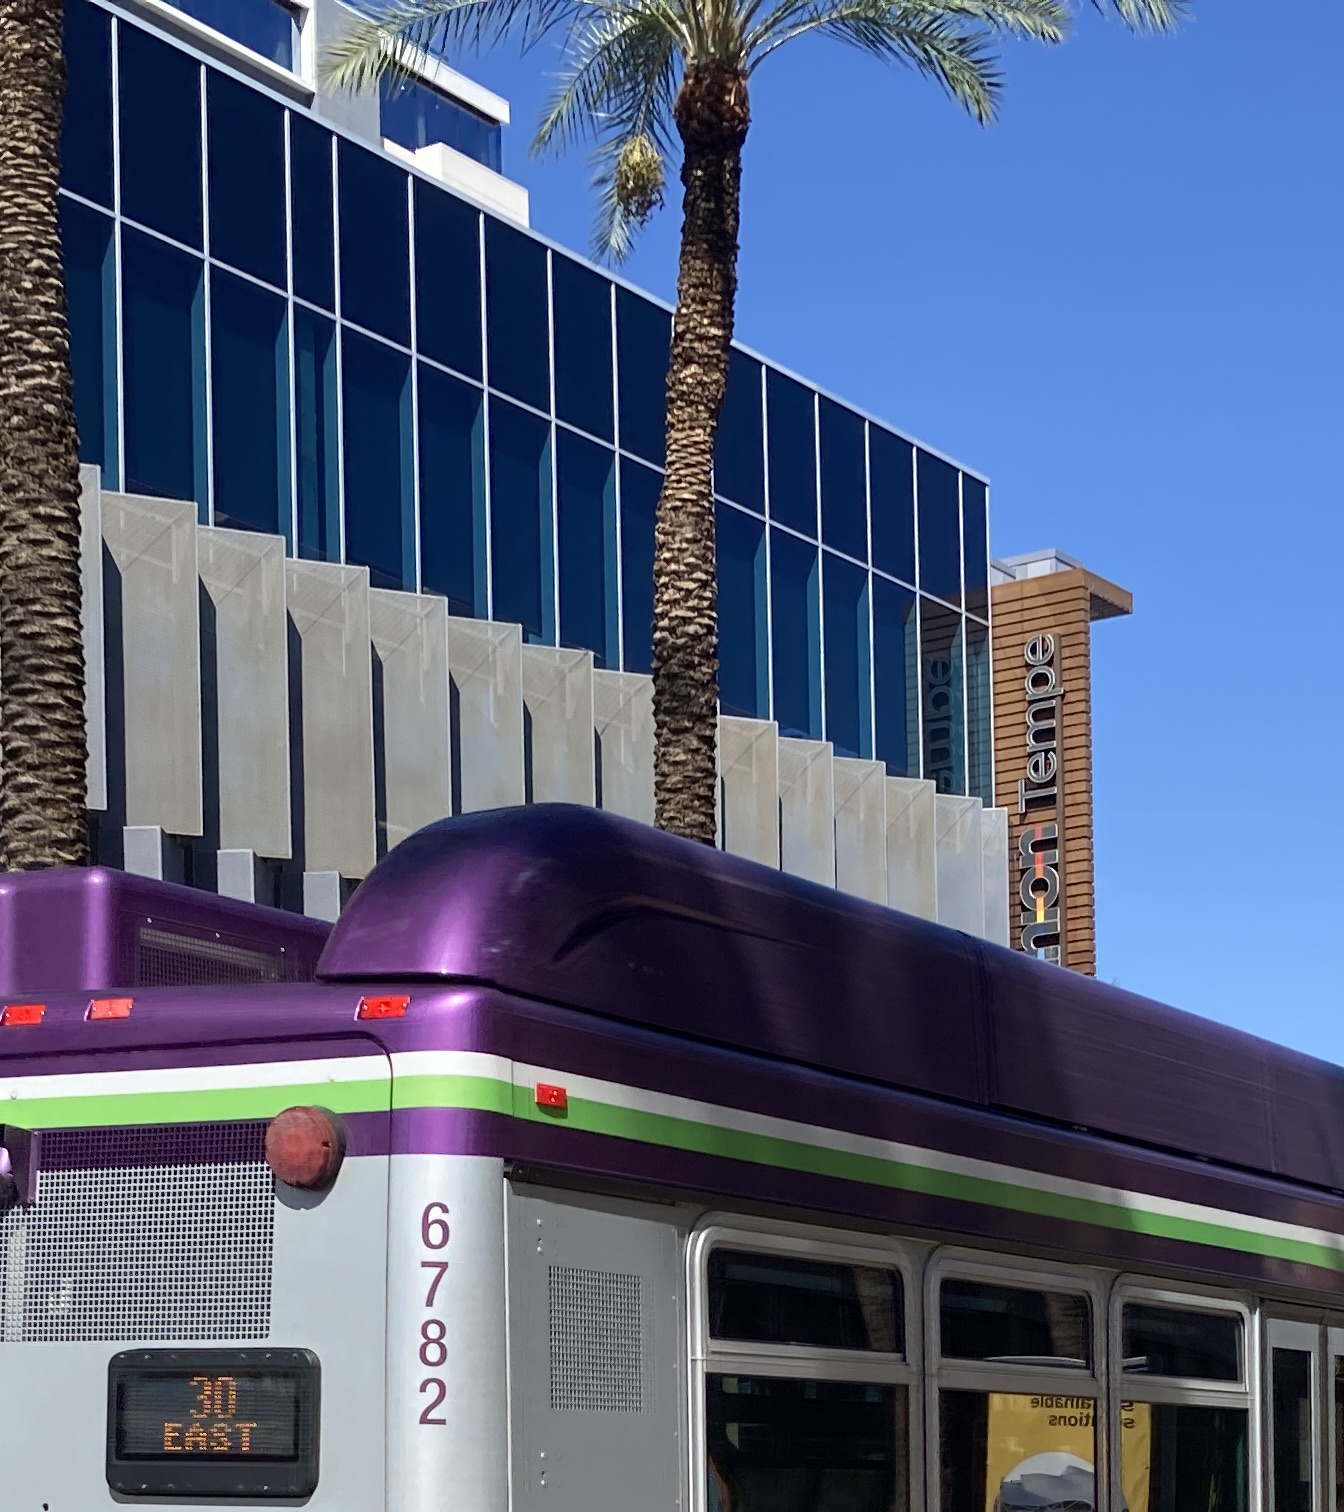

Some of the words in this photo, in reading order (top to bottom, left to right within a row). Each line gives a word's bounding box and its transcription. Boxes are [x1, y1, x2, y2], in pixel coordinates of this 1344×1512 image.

[1018, 633, 1064, 813] Tempe
[1019, 823, 1061, 966] nion
[419, 1201, 450, 1426] 6782
[163, 1422, 257, 1451] EAST
[189, 1376, 237, 1418] 30
